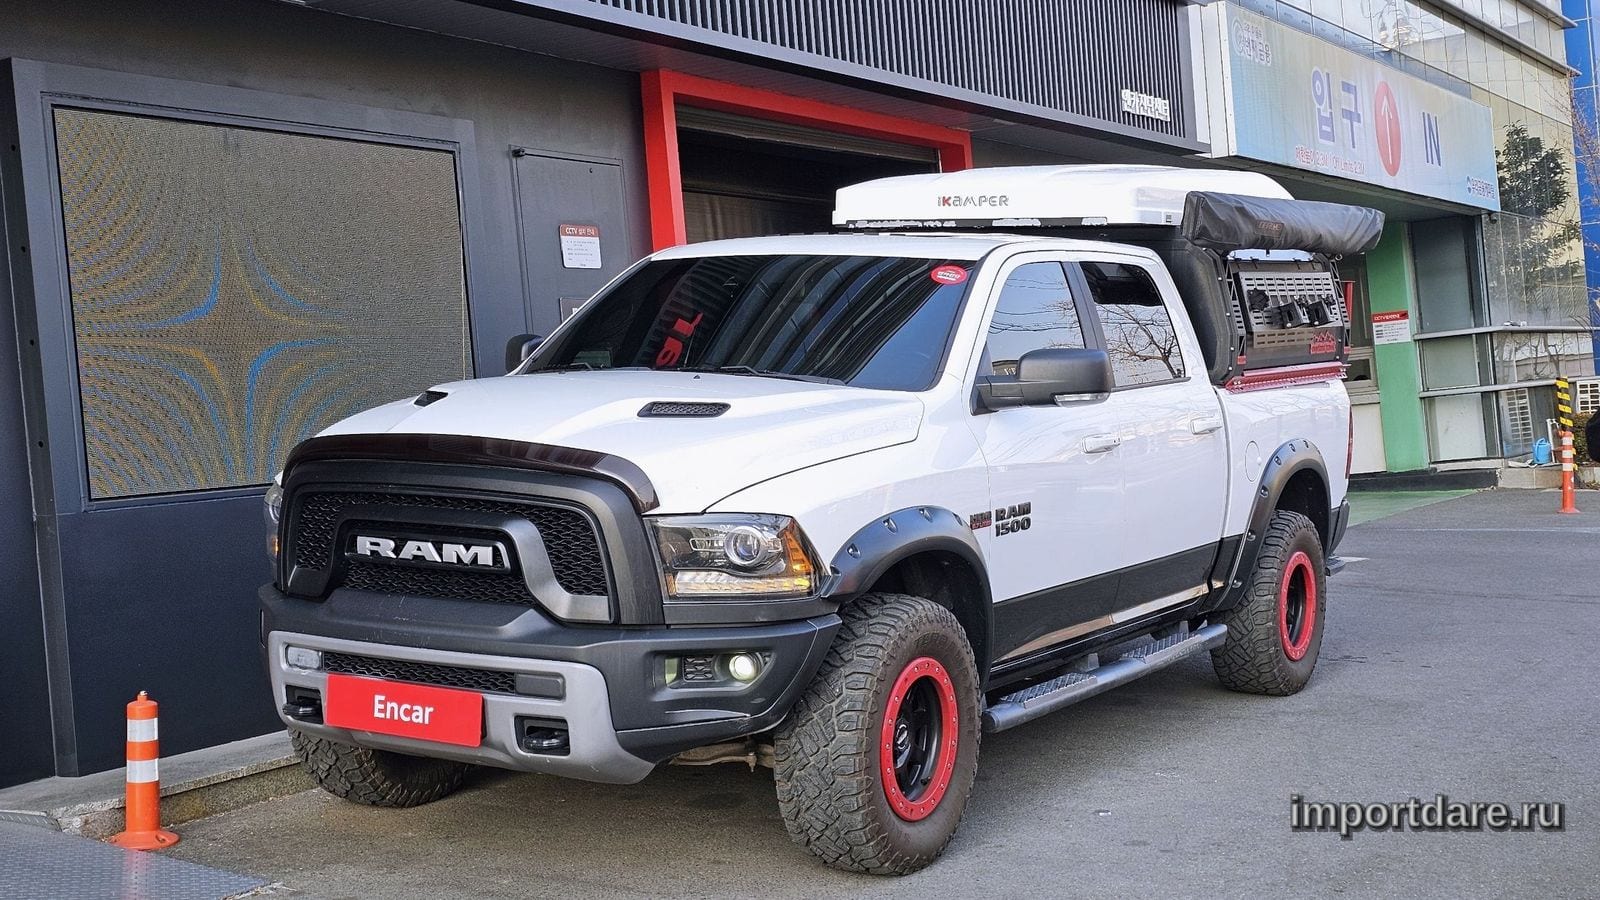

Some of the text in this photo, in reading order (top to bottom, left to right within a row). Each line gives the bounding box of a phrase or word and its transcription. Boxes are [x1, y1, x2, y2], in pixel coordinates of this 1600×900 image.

[1311, 70, 1362, 149] 입구
[1422, 111, 1442, 167] IN
[565, 227, 578, 235] CCTV
[995, 501, 1031, 521] RAM
[995, 517, 1031, 537] 1500
[356, 535, 493, 566] RAM
[374, 694, 434, 725] Encar
